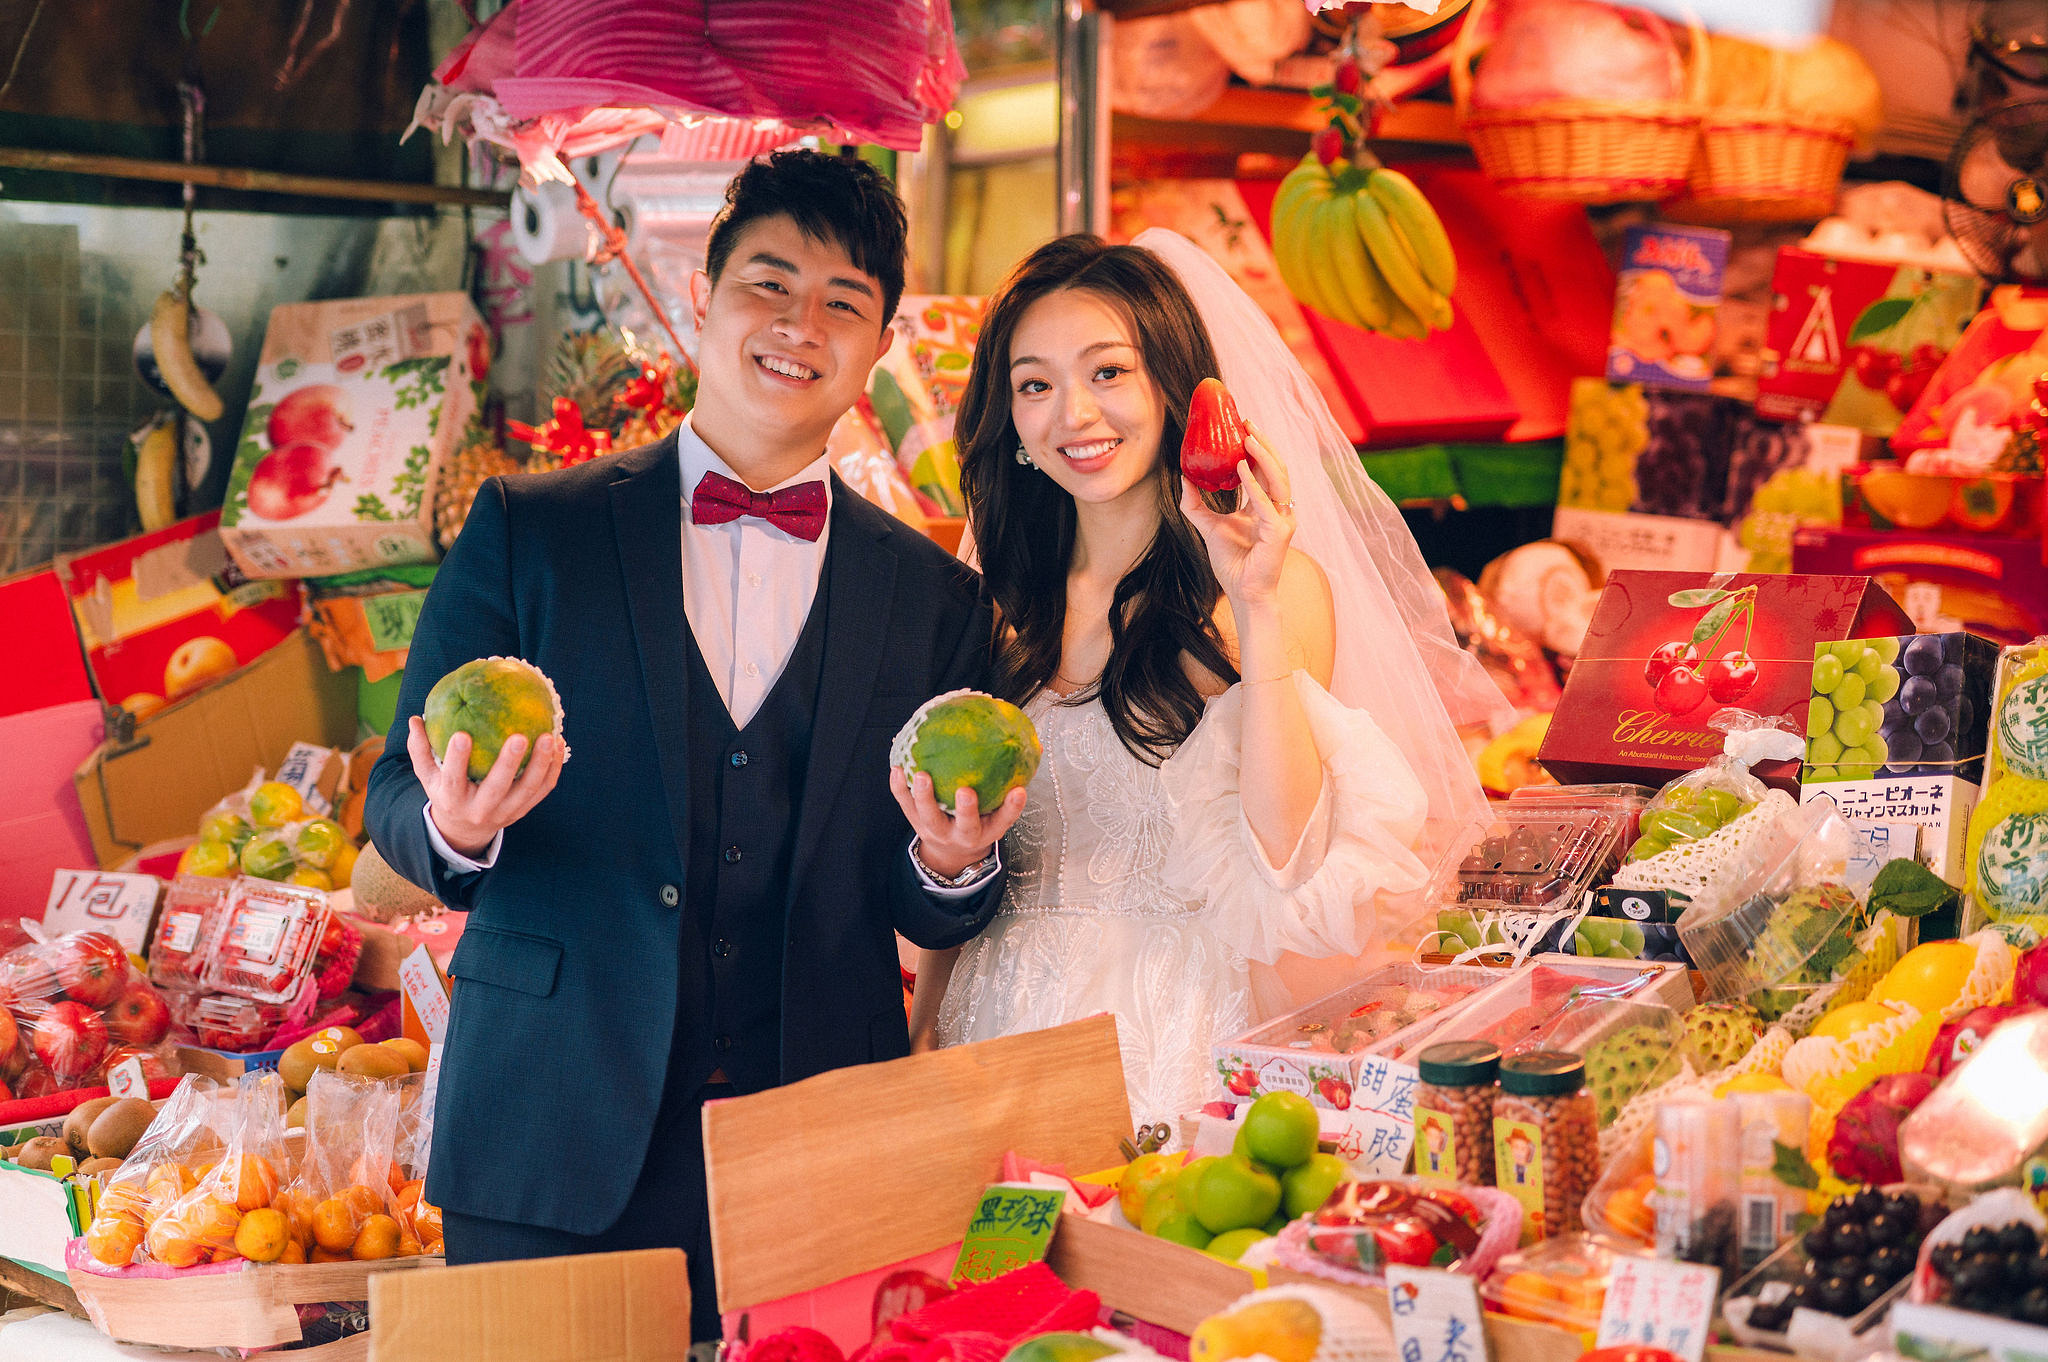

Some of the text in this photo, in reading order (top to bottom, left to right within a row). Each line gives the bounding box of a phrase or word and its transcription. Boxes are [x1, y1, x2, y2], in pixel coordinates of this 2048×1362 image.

[1628, 750, 1659, 759] Abundant
[1659, 752, 1684, 761] Harvest
[1843, 785, 1944, 804] ニューピオーネ
[1842, 804, 1941, 818] シャインマスカット
[969, 1194, 1057, 1236] 黑珍珠
